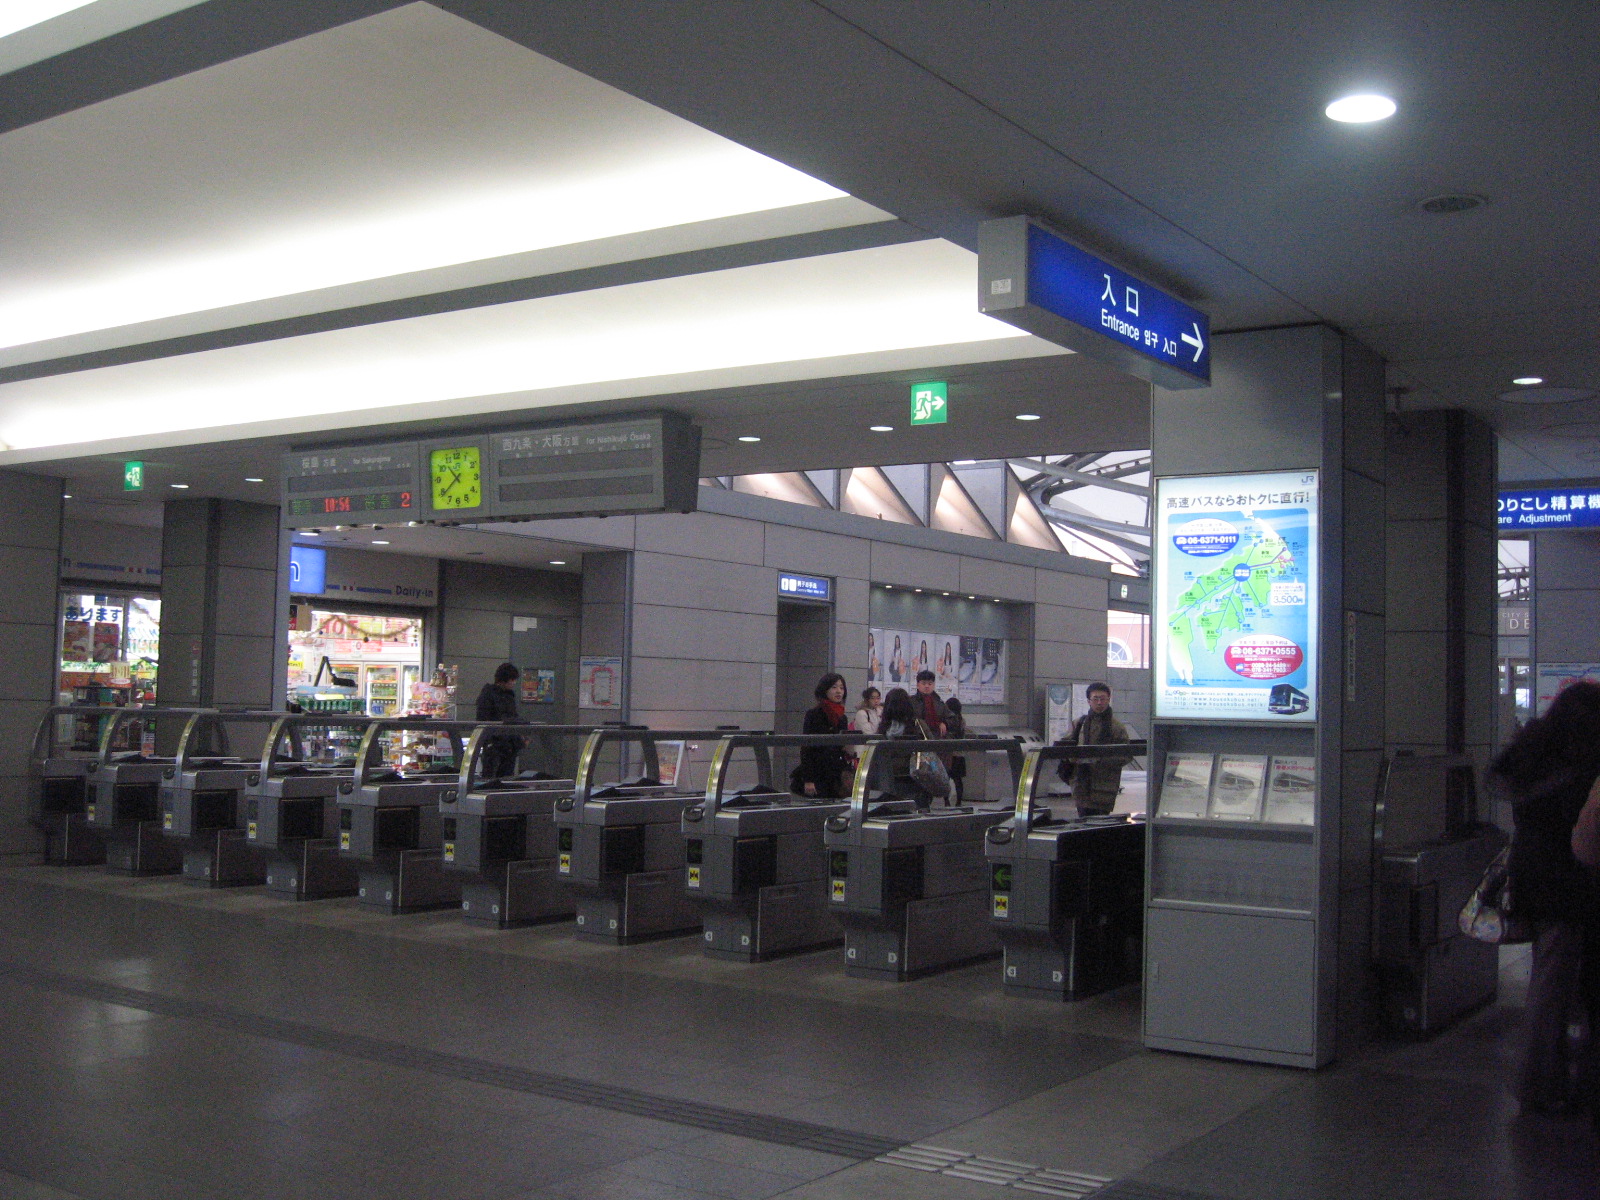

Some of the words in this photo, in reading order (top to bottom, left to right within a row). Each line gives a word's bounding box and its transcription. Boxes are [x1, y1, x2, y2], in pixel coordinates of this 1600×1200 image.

[1101, 273, 1139, 317] 入口
[1101, 308, 1140, 341] Entrance
[1144, 329, 1159, 348] 입구
[1163, 337, 1177, 358] 入口
[1301, 475, 1315, 483] JR
[325, 497, 350, 513] 10:54
[401, 492, 410, 508] 2
[1498, 516, 1512, 524] are
[1519, 513, 1572, 524] Adjustment
[65, 606, 122, 622] あります
